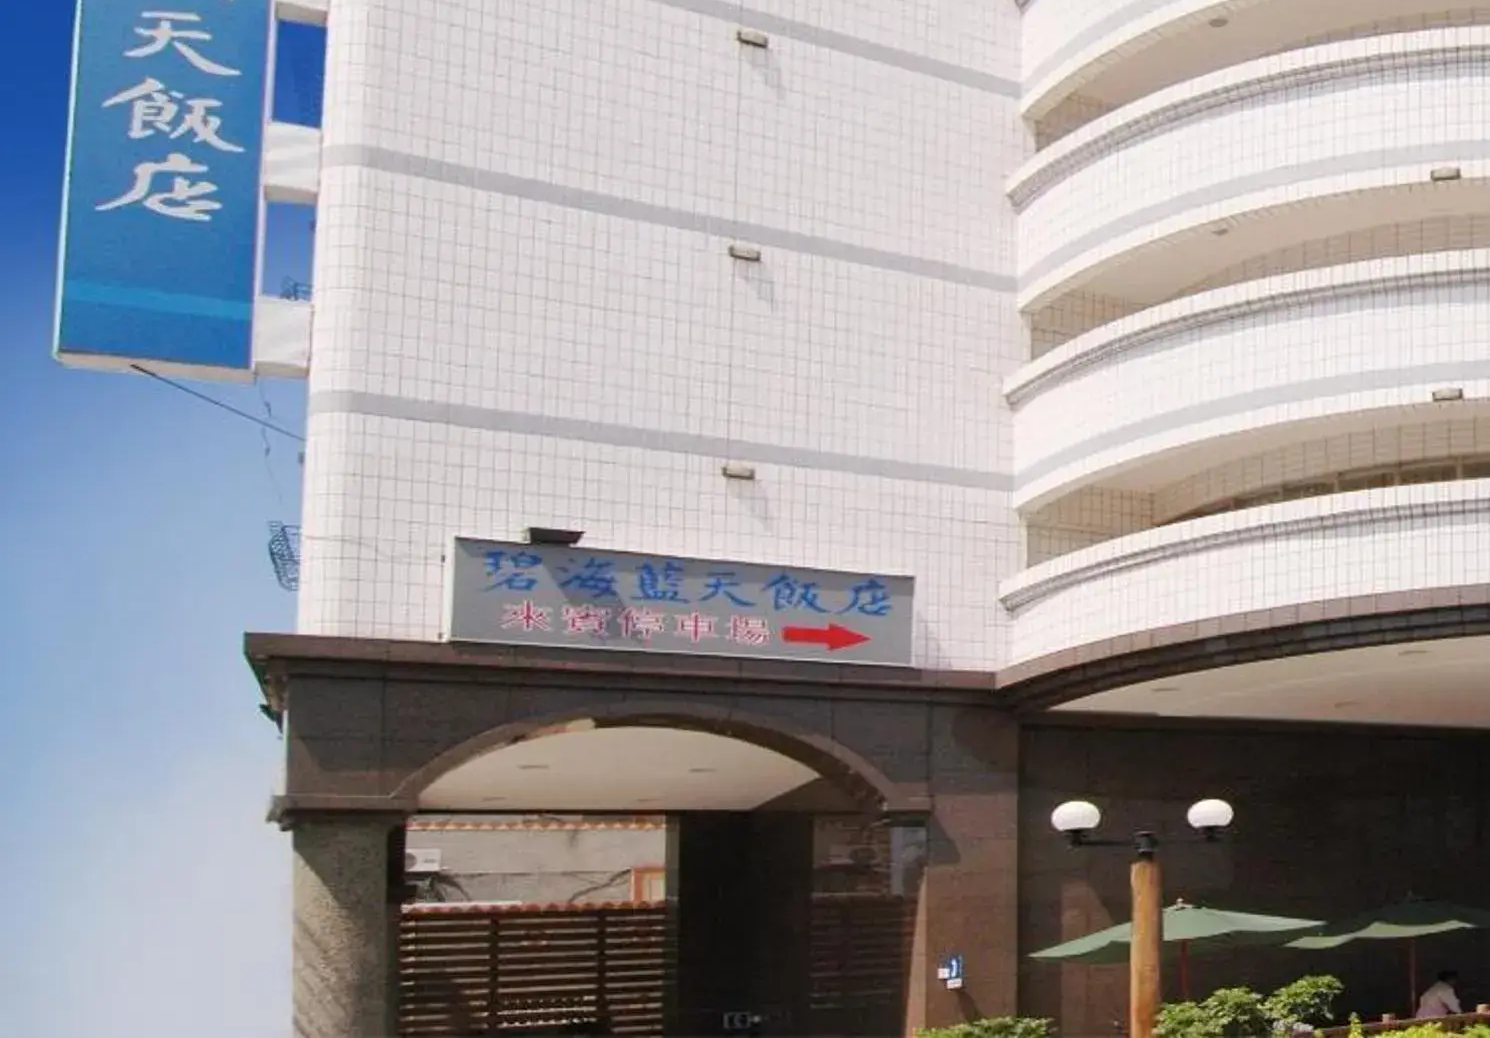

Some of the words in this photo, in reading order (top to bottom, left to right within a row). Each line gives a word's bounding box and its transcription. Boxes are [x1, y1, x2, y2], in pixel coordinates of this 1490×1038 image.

[482, 550, 894, 619] 碧海藍天飯店
